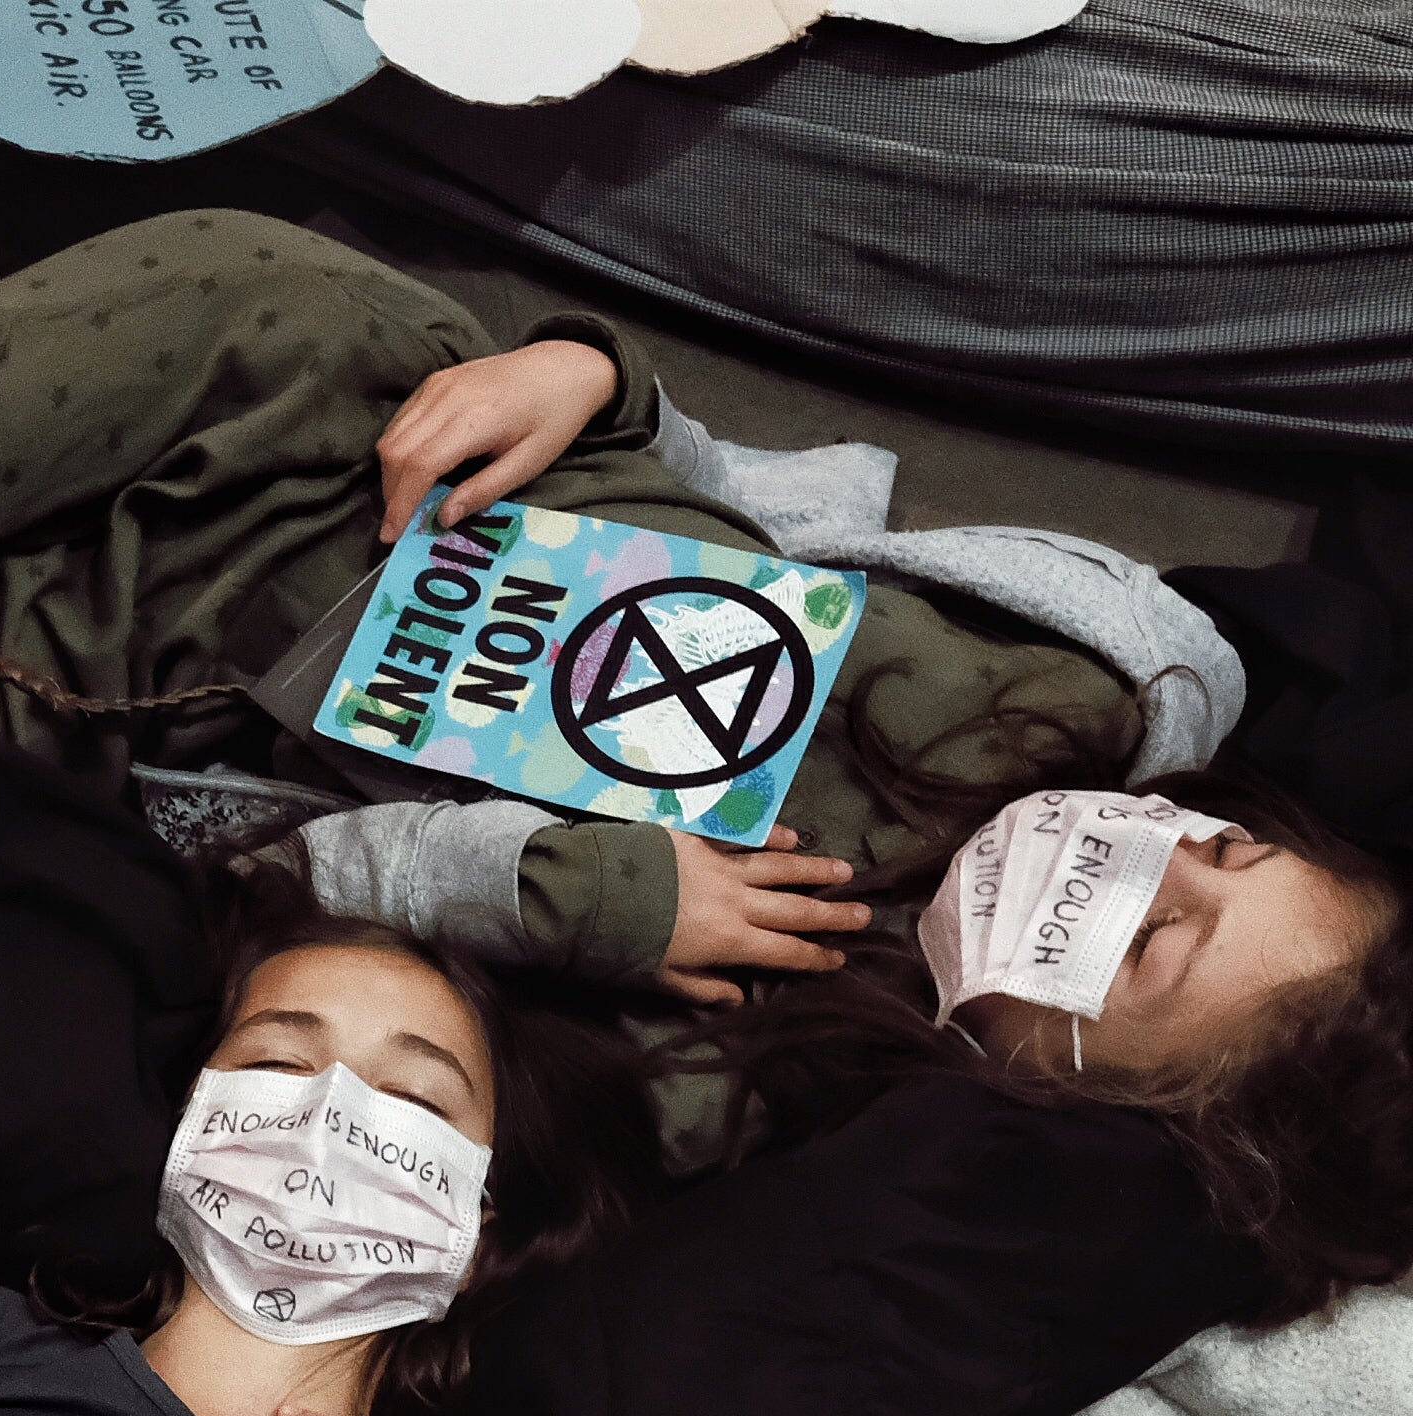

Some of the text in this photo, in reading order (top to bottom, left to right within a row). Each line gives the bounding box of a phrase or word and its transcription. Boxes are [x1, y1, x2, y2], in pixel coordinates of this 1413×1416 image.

[169, 35, 219, 84] CAR
[244, 64, 283, 91] OF
[104, 50, 175, 142] BALLOONS
[354, 513, 516, 749] VIOLENT
[452, 574, 569, 713] NON
[1032, 791, 1068, 836] ON
[1034, 834, 1114, 967] ENOUGH
[202, 1106, 451, 1195] ENOUGH IS ENOUGH
[189, 1178, 232, 1220] AIR
[283, 1168, 336, 1208] ON
[244, 1215, 416, 1265] POLLUTION
